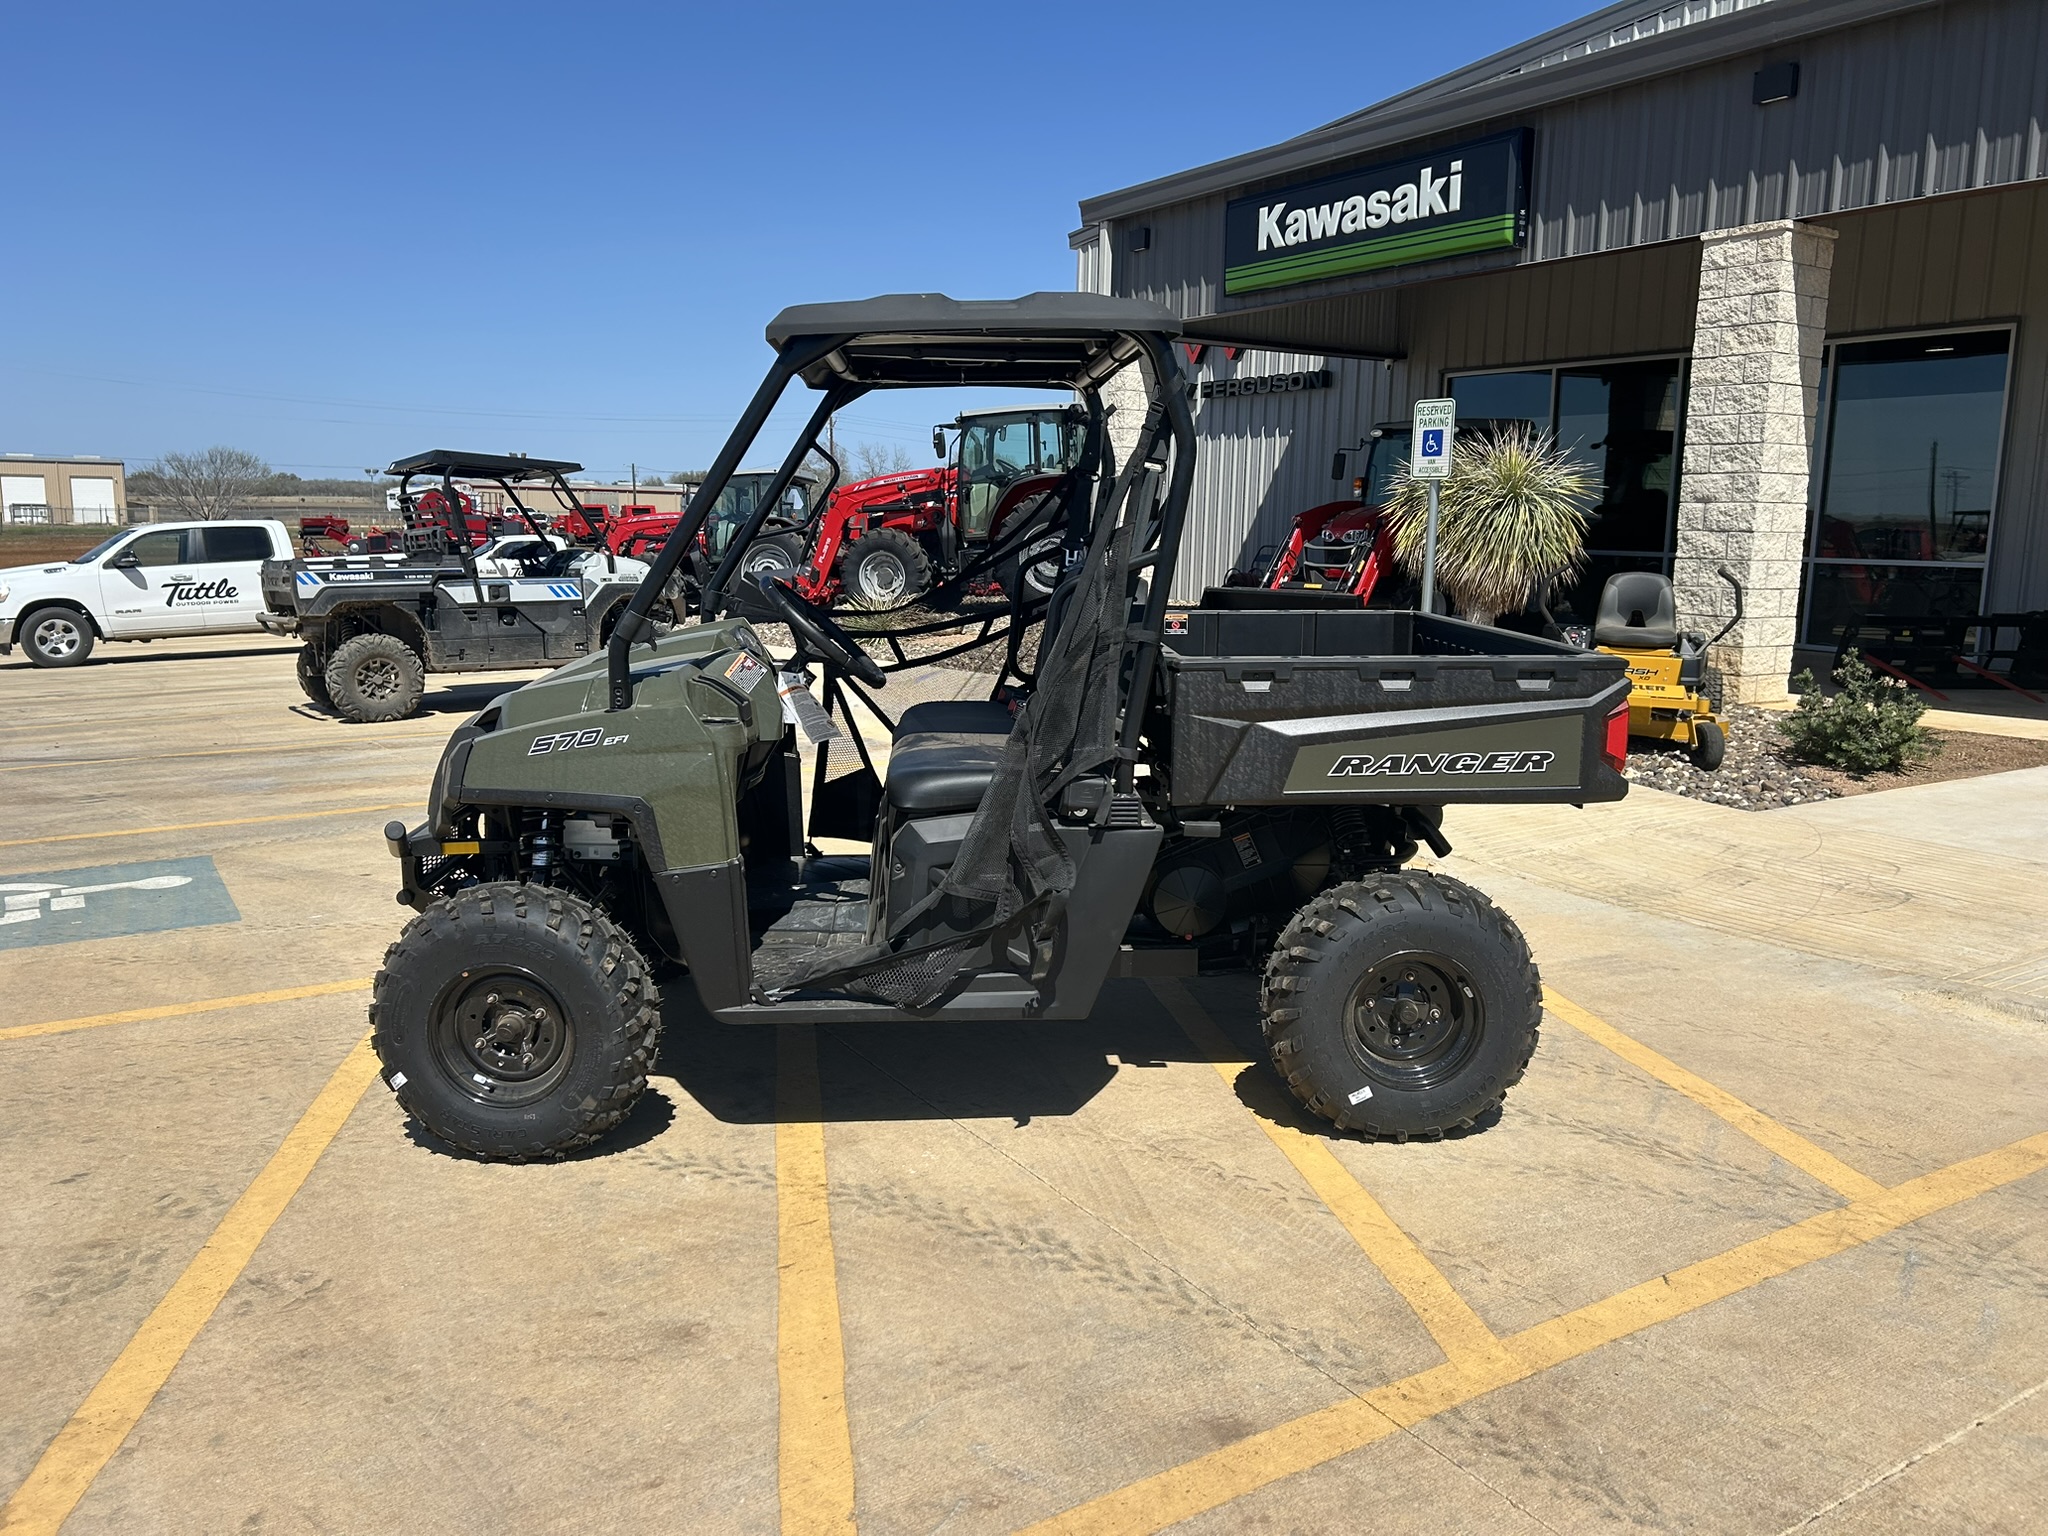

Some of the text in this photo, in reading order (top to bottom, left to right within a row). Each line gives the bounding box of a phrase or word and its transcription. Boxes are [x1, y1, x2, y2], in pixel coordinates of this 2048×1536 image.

[1257, 159, 1463, 252] Kawasaki
[1201, 370, 1328, 399] FERGUSON
[1417, 404, 1452, 417] RESERVED
[1419, 416, 1450, 428] PARKING
[1418, 466, 1444, 474] ACCESSIBLE
[328, 572, 374, 581] Kawasaki
[161, 578, 239, 607] Tuttle
[1624, 668, 1659, 676] ASH
[527, 727, 630, 756] 570 EFI
[1327, 751, 1555, 777] RANGER
